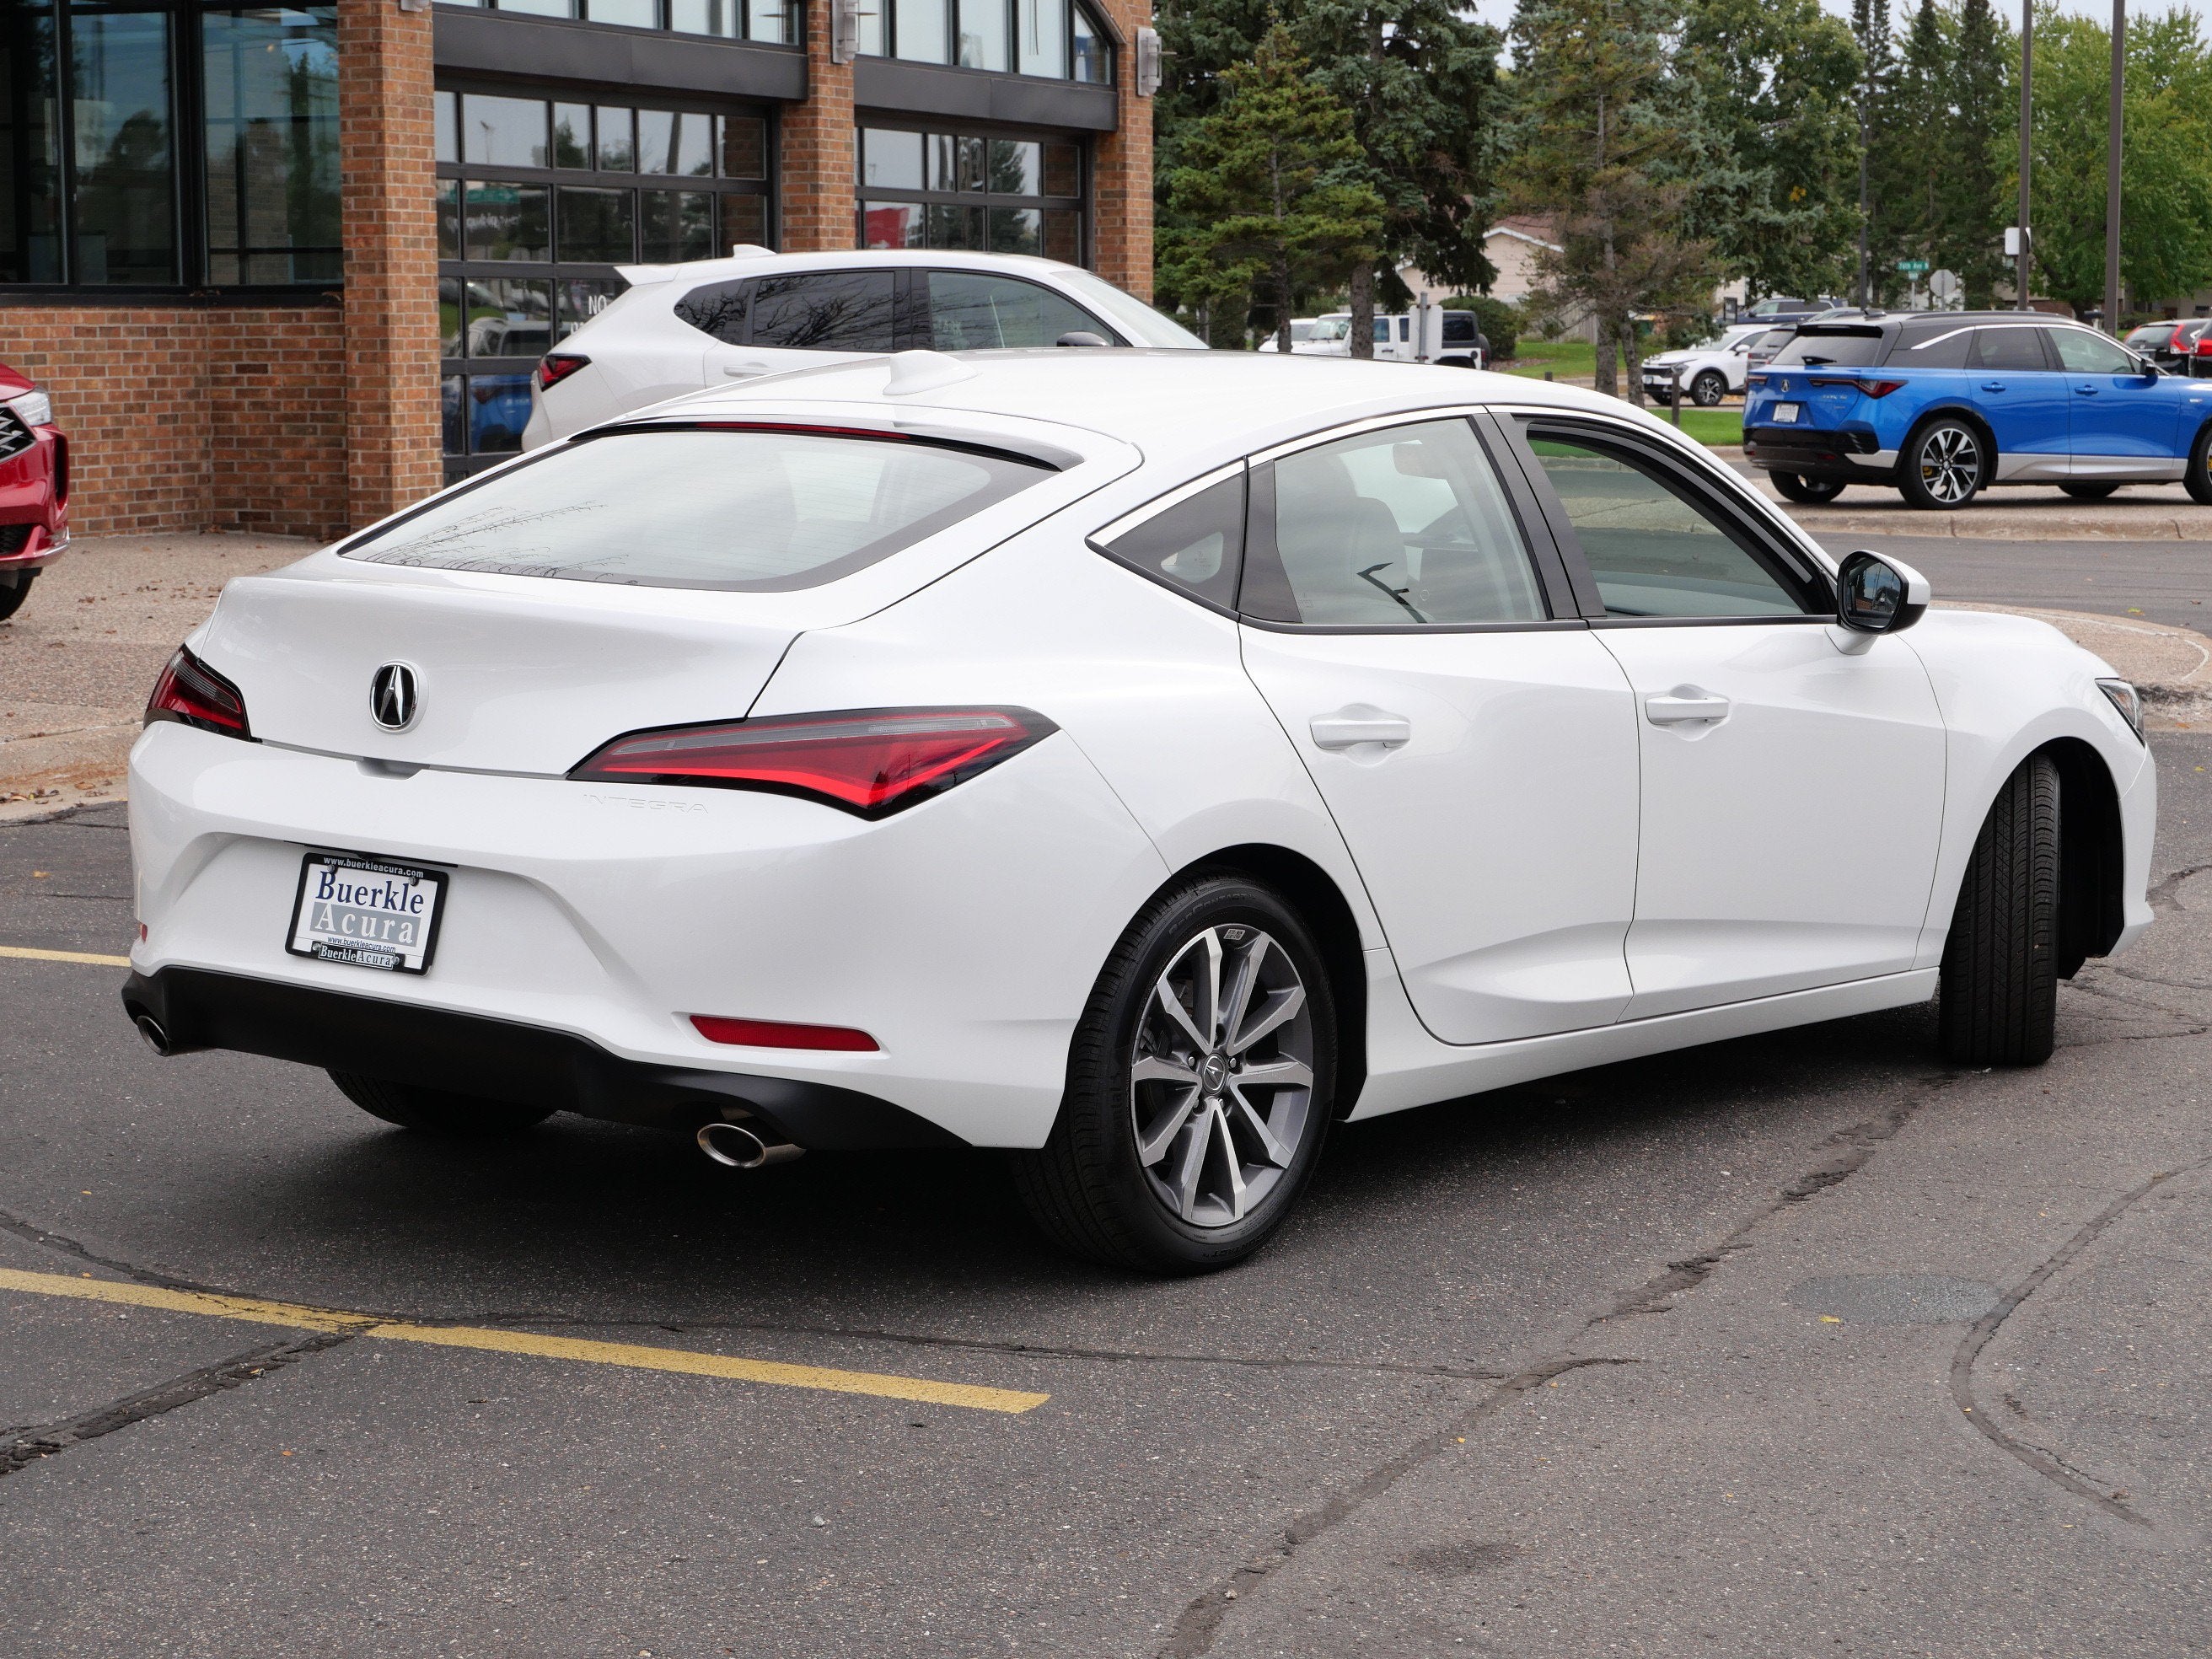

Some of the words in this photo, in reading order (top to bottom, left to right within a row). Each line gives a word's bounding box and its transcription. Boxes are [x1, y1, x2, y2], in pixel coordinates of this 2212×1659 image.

[588, 295, 607, 314] NO
[583, 794, 709, 814] INTEGRA
[324, 856, 424, 878] www.buerkleacura.com
[315, 871, 424, 914] Buerkle
[314, 904, 413, 944] Acura
[327, 936, 396, 953] www.buerkleacura.com
